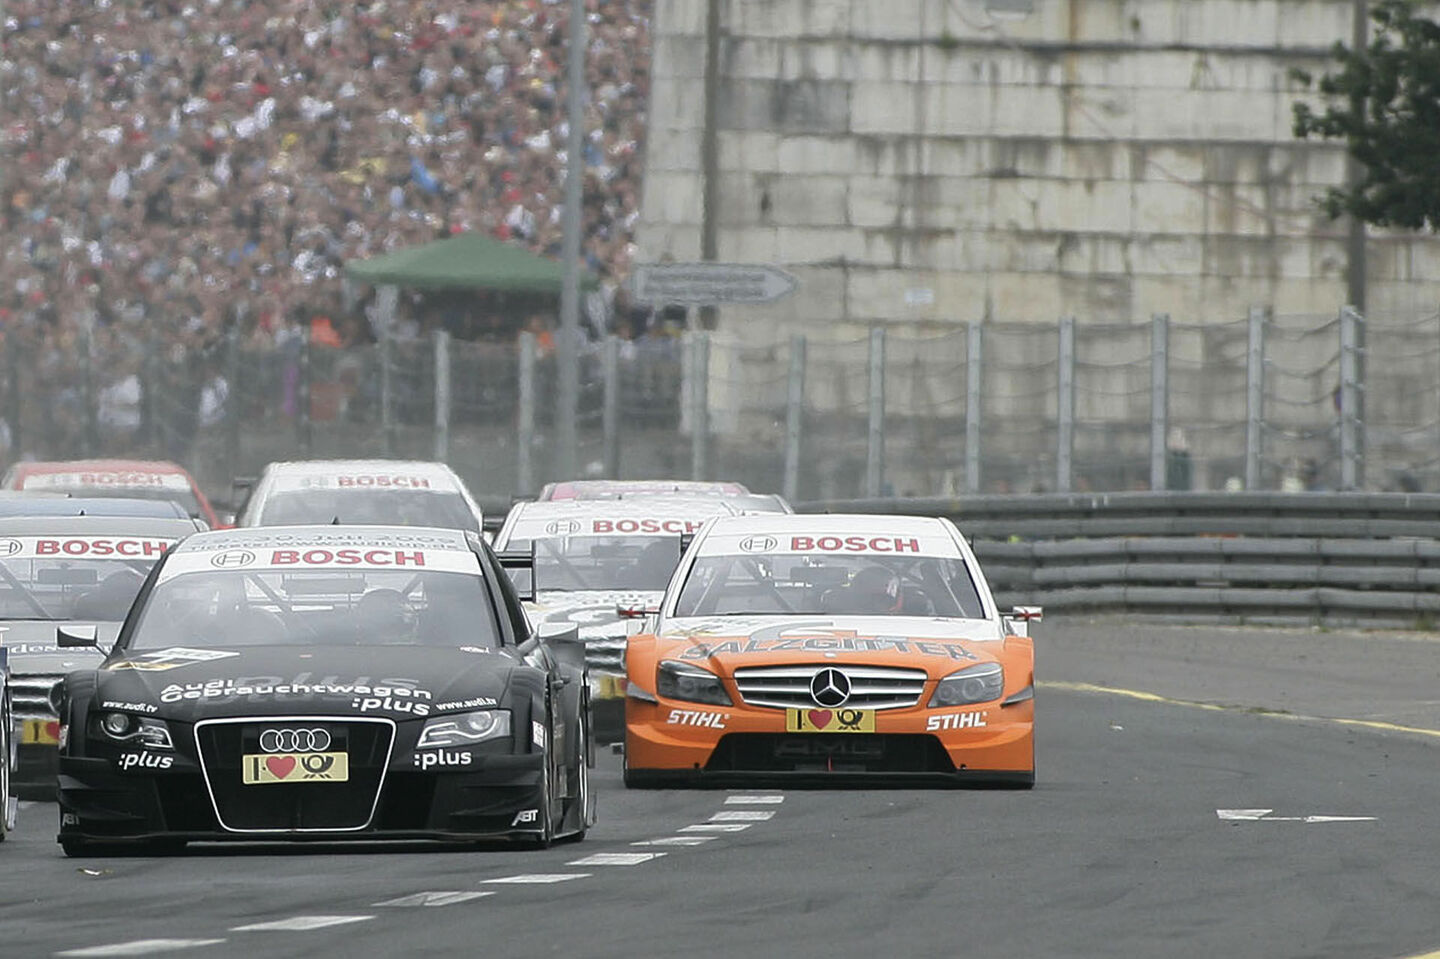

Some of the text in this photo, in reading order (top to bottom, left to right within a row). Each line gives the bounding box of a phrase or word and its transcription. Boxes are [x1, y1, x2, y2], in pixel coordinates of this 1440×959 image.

[81, 473, 163, 486] BOSCH
[338, 476, 430, 489] BOSCH
[35, 540, 167, 556] BOSCH
[790, 536, 920, 552] BOSCH
[271, 550, 425, 566] BOSCH
[679, 637, 979, 662] SALZGITTER
[161, 679, 233, 694] Audi
[161, 683, 432, 703] Gebrauchtwagen
[102, 701, 158, 713] www.audi.tv
[352, 697, 430, 716] :plus
[436, 697, 497, 711] www.audi.tv
[118, 752, 174, 770] :plus
[413, 749, 472, 767] :plus
[62, 813, 80, 827] ABT
[511, 809, 539, 827] ABT
